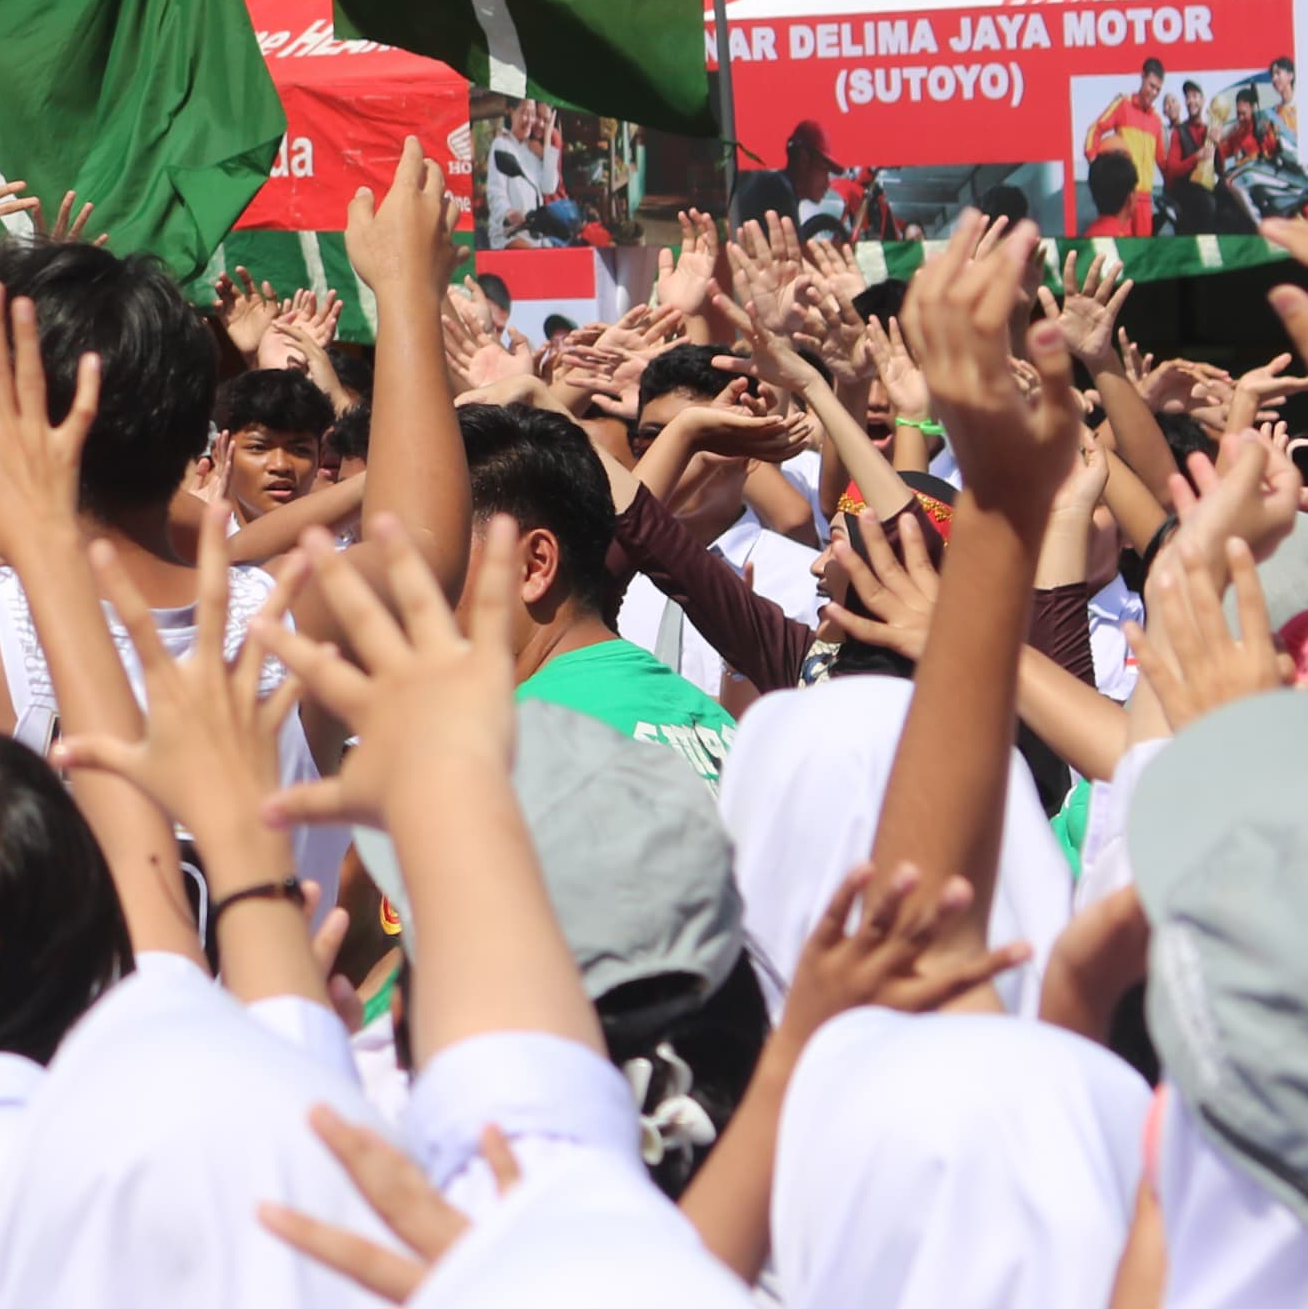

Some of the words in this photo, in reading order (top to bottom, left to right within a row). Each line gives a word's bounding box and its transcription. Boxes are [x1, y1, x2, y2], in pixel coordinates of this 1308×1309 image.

[788, 18, 938, 60] DELIMA
[949, 11, 1050, 53] JAYA
[1063, 4, 1213, 48] MOTOR
[834, 61, 1025, 113] (SUTOYO)
